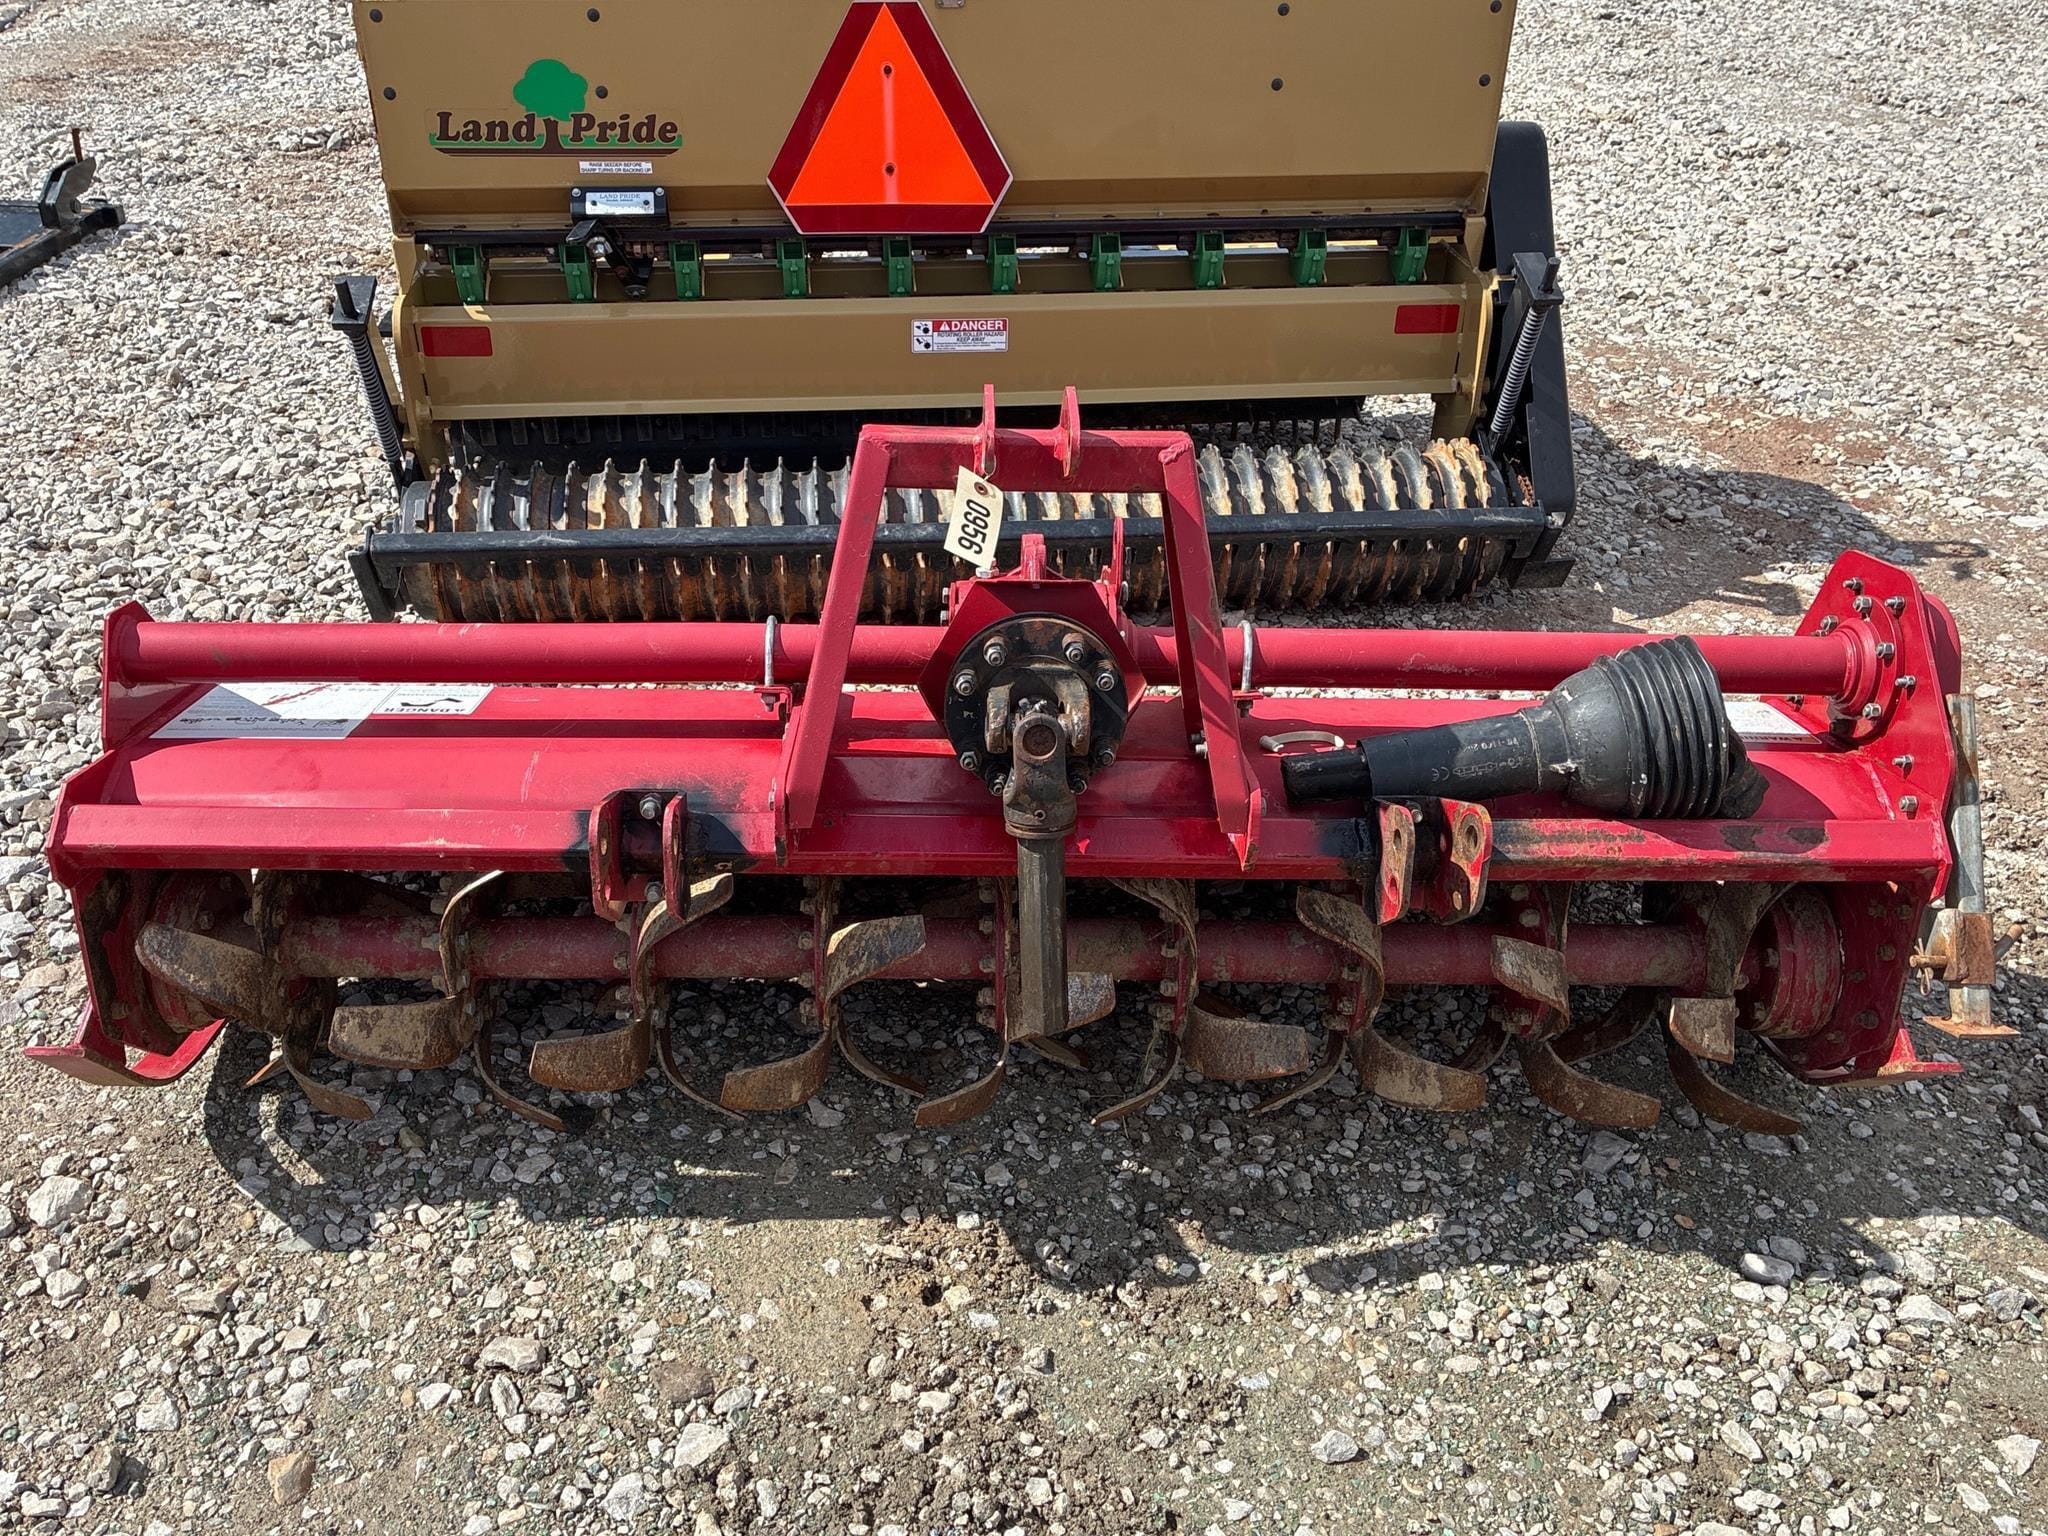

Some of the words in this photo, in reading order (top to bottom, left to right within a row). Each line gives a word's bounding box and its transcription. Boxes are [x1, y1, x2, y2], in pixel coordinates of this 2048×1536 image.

[436, 111, 536, 142] Land
[570, 113, 679, 143] Pride
[951, 320, 1003, 331] DANGER
[957, 498, 991, 555] 0956
